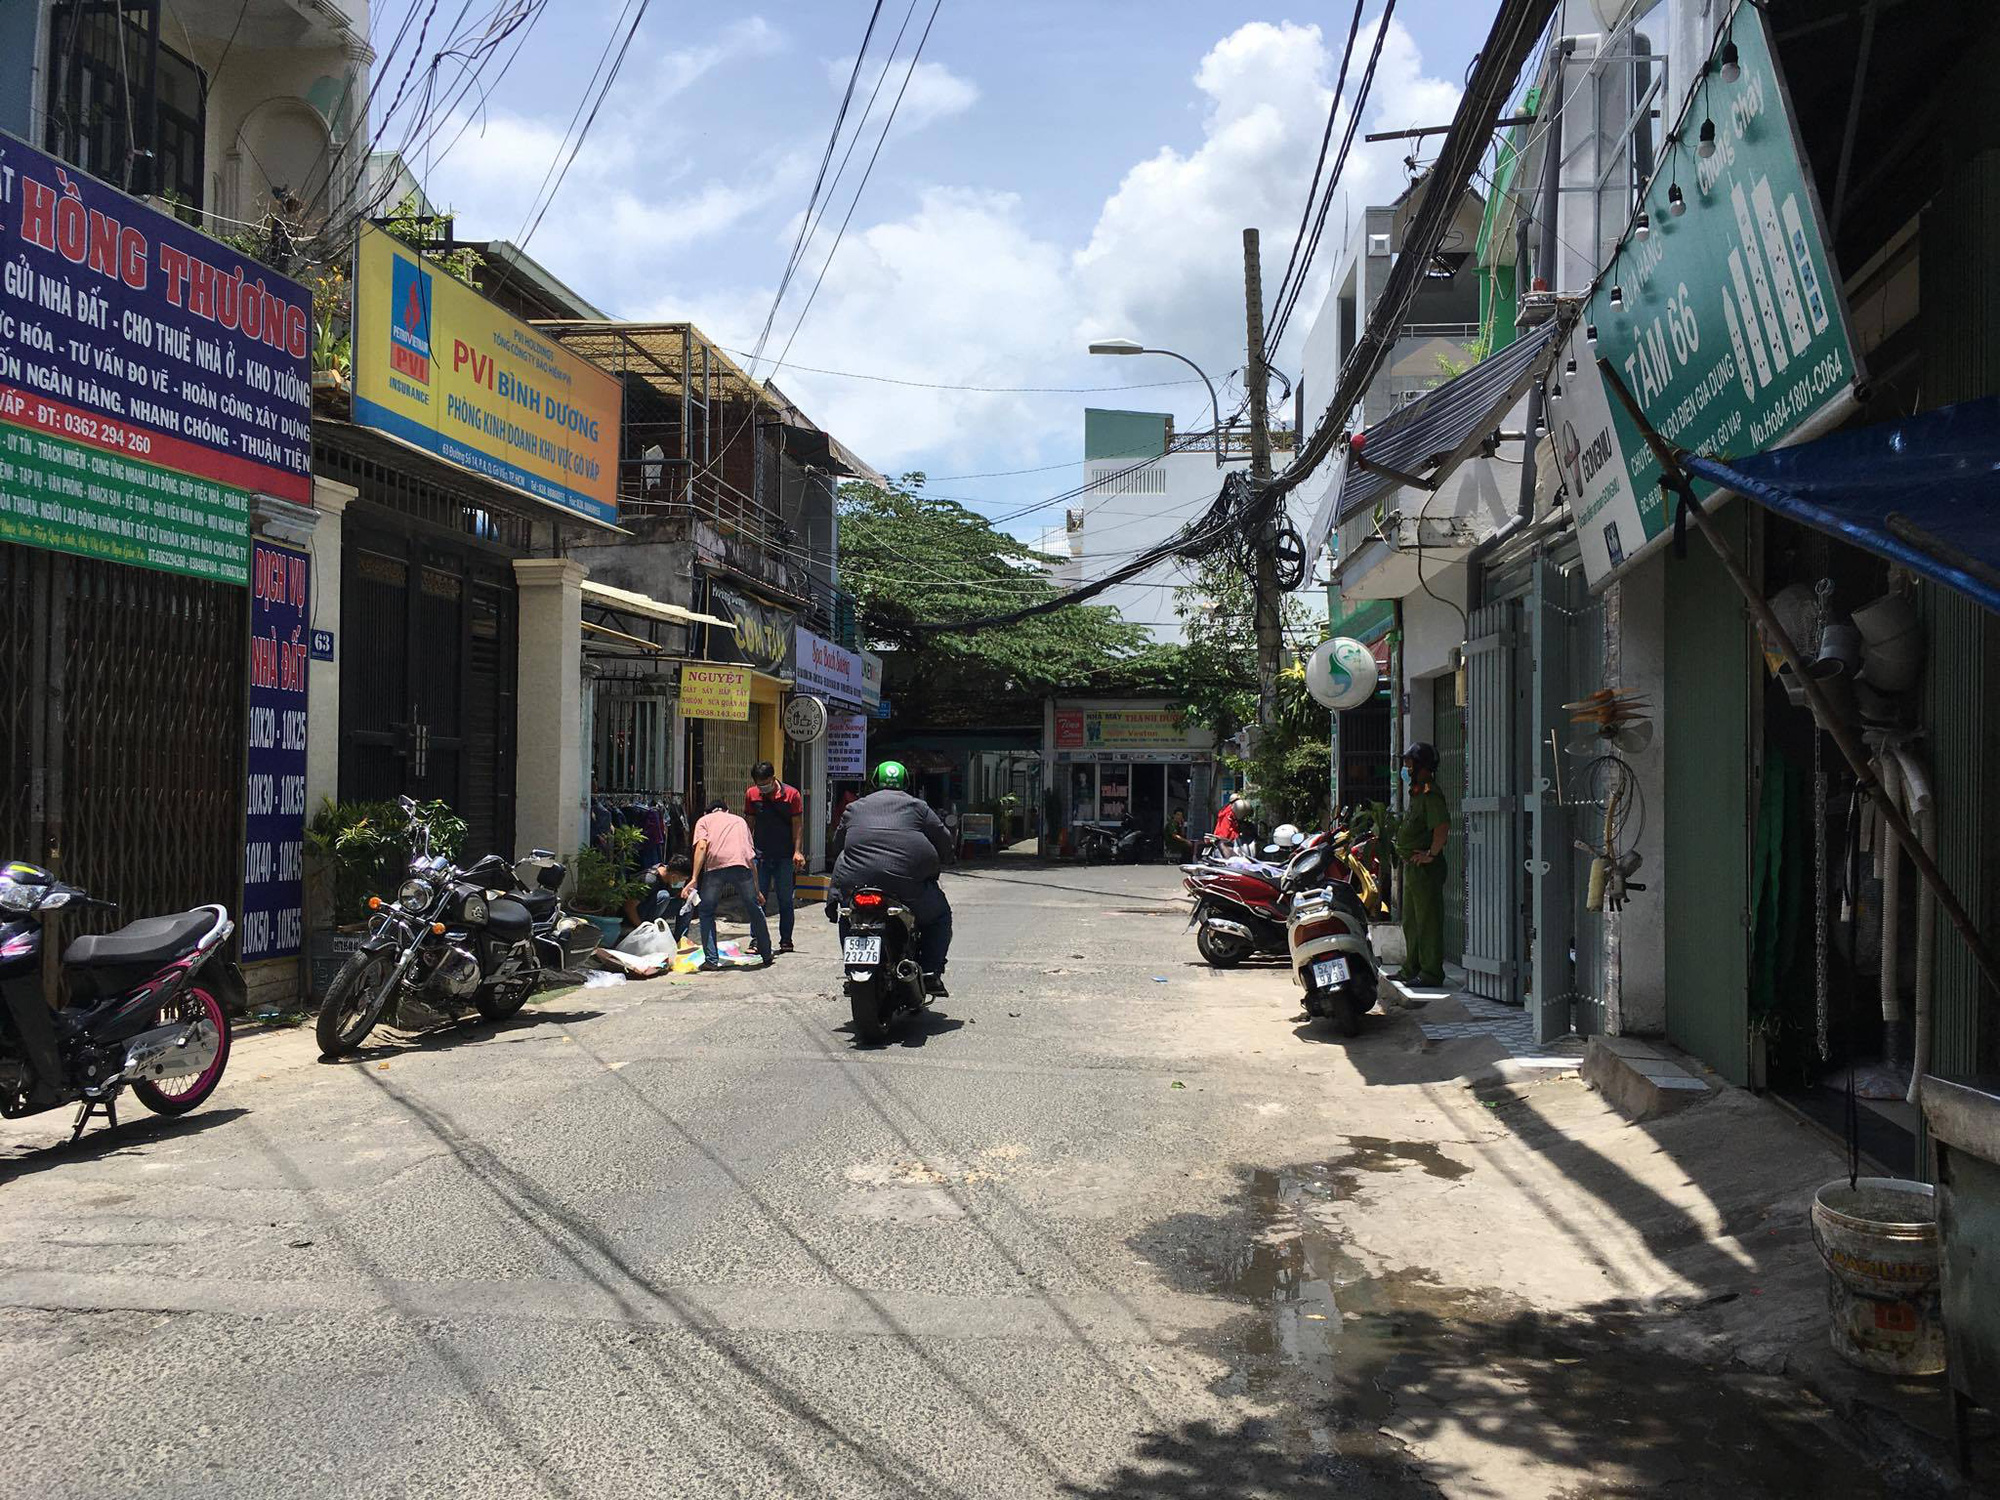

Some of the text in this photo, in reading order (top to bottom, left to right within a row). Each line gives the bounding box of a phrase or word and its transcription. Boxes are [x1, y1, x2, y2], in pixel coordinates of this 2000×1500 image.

[21, 166, 307, 359] HỒNG THƯƠNG
[1636, 231, 1663, 288] HÀNG
[5, 253, 311, 409] GỬI NHÀ ĐẤT CHO THUÊ NHÀ Ở KHO XƯỞNG
[1624, 281, 1700, 414] TÂM 66
[20, 322, 311, 443] HÓA TƯ VẤN ĐO VẼ HOÀN CÔNG XÂY DỰNG
[396, 345, 425, 381] PVI
[389, 376, 430, 405] INSURANCE
[453, 338, 600, 443] PVI BÌNH DƯƠNG
[1666, 352, 1736, 441] ĐỒ ĐIỆN GIA DỤNG
[1749, 346, 1843, 449] No.Ho84-1801-C064
[26, 363, 311, 473] NGÂN HÀNG. NHANH CHÓNG THUẬN TIỆN
[37, 404, 151, 454] ĐT: 0362 294 260
[447, 393, 481, 430] PHÒNG
[483, 410, 506, 441] KINH
[508, 423, 537, 456] DOANH
[539, 437, 555, 464] KHU
[557, 446, 573, 473] VỰC
[573, 450, 584, 476] GÒ
[1717, 419, 1730, 446] GÒ
[1726, 409, 1742, 437] VẤP
[38, 440, 62, 463] TRÁCH
[91, 457, 110, 477] CUNG
[148, 471, 160, 490] LAO
[442, 443, 449, 455] 63
[63, 506, 77, 525] LAO
[255, 547, 306, 618] DỊCH VỤ
[251, 624, 307, 693] NHÀ ĐẤT
[314, 632, 330, 652] 63
[812, 639, 823, 671] Spa
[688, 671, 744, 686] NGUYỆT
[249, 706, 306, 751] 10X20 10X25
[247, 773, 305, 816] 10X30 10X35
[244, 841, 303, 884] 10X40 10X45
[242, 910, 270, 954] 10X50
[276, 907, 302, 950] 10X55
[849, 939, 876, 951] 59-P2
[845, 951, 878, 962] 232.76
